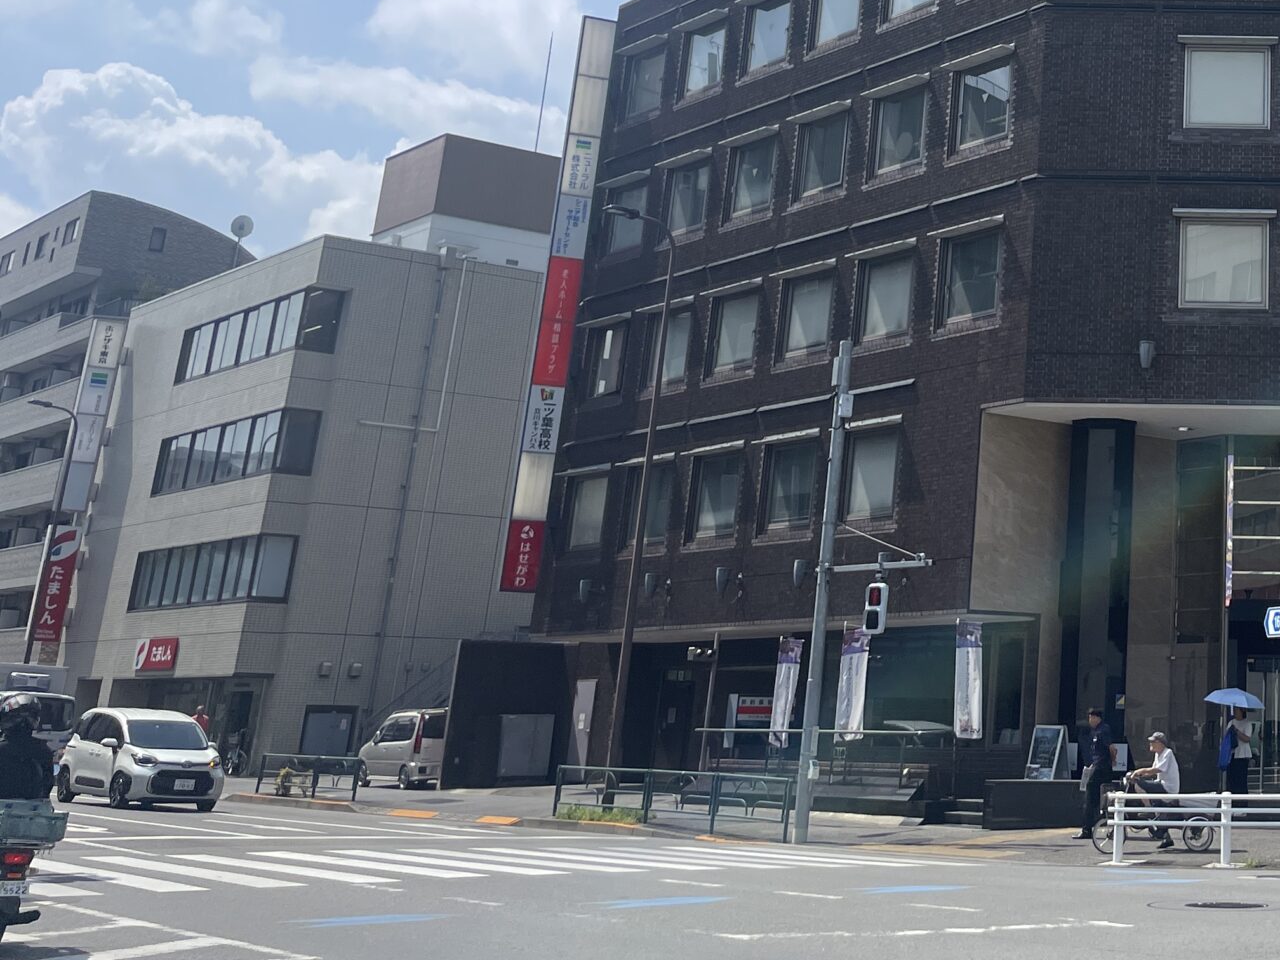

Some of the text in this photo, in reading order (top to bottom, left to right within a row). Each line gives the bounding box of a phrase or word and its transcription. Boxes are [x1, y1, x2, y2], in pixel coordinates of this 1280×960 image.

[513, 541, 531, 587] はせがわ
[40, 565, 64, 625] たましん
[150, 645, 172, 662] たましん
